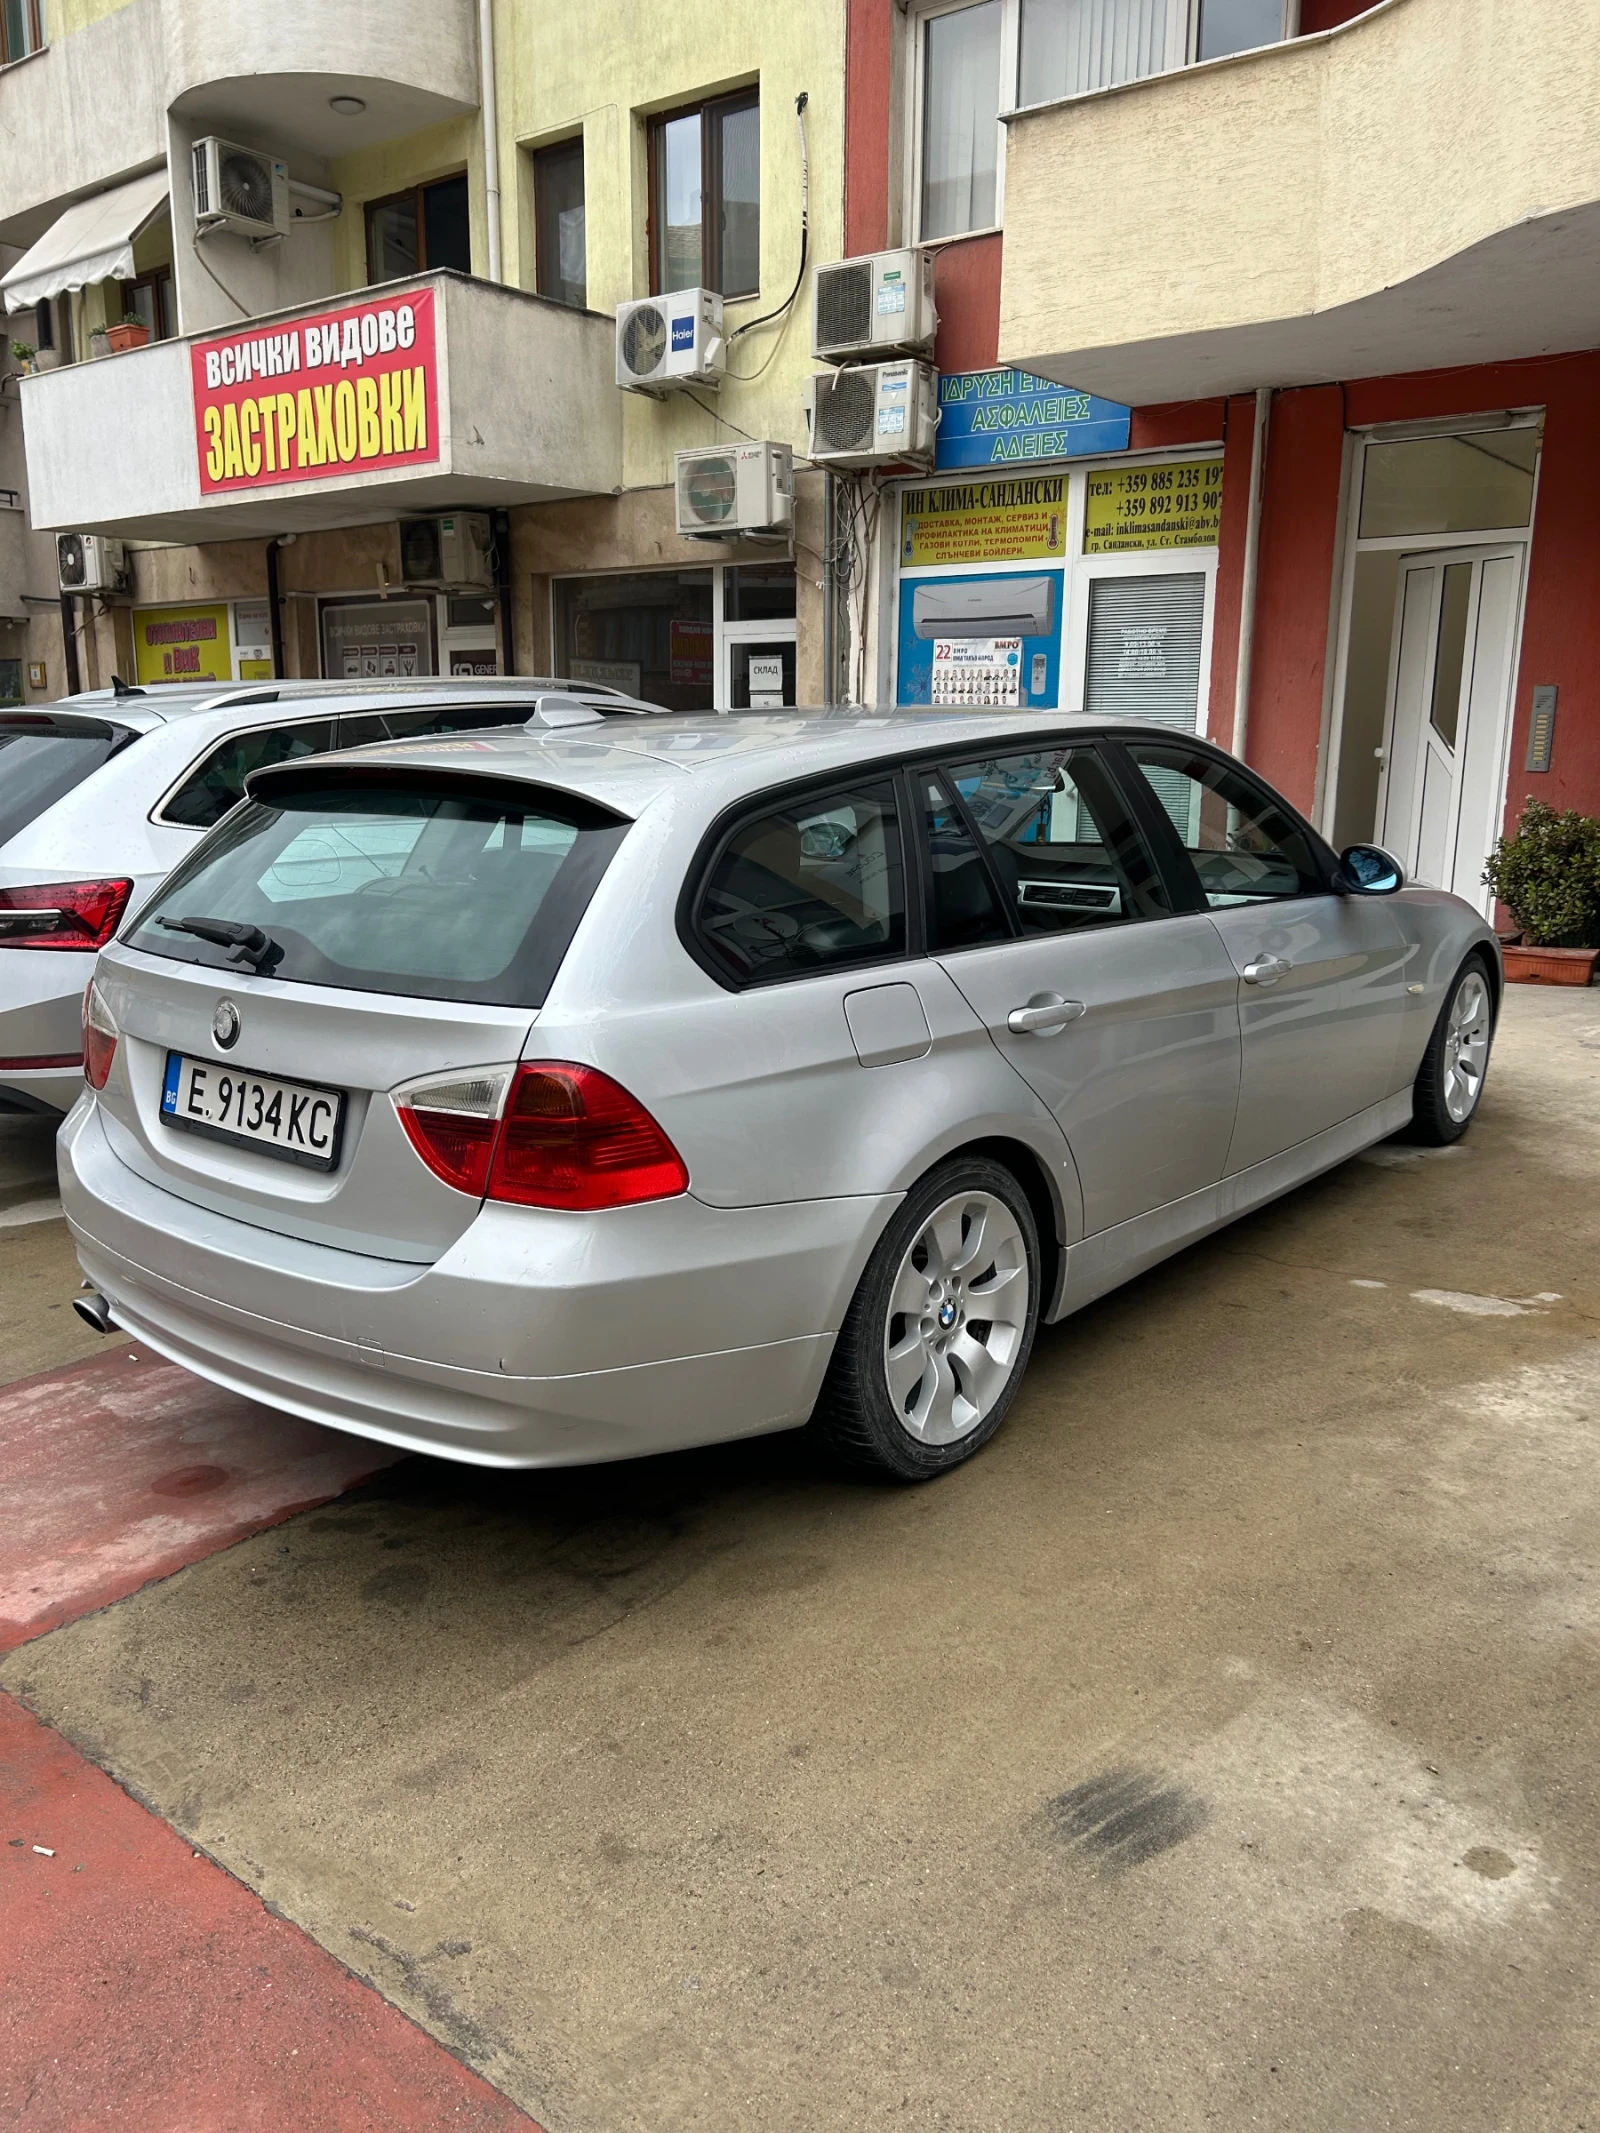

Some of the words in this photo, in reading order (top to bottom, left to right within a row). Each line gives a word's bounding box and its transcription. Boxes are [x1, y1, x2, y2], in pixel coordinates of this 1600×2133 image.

[672, 329, 694, 341] Haier
[882, 368, 908, 377] Panasonic
[942, 371, 1013, 401] ΙΔΡΥΣΗ
[971, 394, 1091, 432] ΑΣΦΑΛΕΙΕΣ
[204, 366, 427, 482] ЗАСТРАХОВКИ
[991, 430, 1068, 461] ΑΔΕΙΕΣ
[1089, 482, 1113, 496] тел:
[1117, 474, 1148, 494] +359
[1151, 471, 1173, 491] 885
[1177, 468, 1200, 488] 235
[906, 491, 924, 515] ИН
[928, 478, 1063, 513] КЛИМА-САНДАНСКИ
[1116, 498, 1146, 517] +359
[1149, 495, 1172, 515] 892
[1175, 493, 1198, 513] 913
[918, 519, 962, 530] ДОСТАВКА,
[964, 515, 1004, 526] МОНТАЖ,
[1006, 513, 1039, 522] СЕРВИЗ
[1085, 523, 1114, 538] e-mail:
[1116, 514, 1220, 536] inklimasandanski@abv.b
[914, 529, 979, 540] ПРОФИЛАКТИКА
[981, 528, 992, 536] НА
[1091, 542, 1101, 552] гр.
[1160, 535, 1172, 546] Ст.
[1174, 533, 1216, 545] Стамболов
[919, 540, 950, 549] ГАЗОВИ
[935, 551, 981, 560] СЛЪНЧЕВИ
[936, 644, 951, 660] 22
[994, 641, 1019, 650] ВМРО
[753, 665, 779, 676] СКЛАД
[165, 1090, 177, 1105] BG
